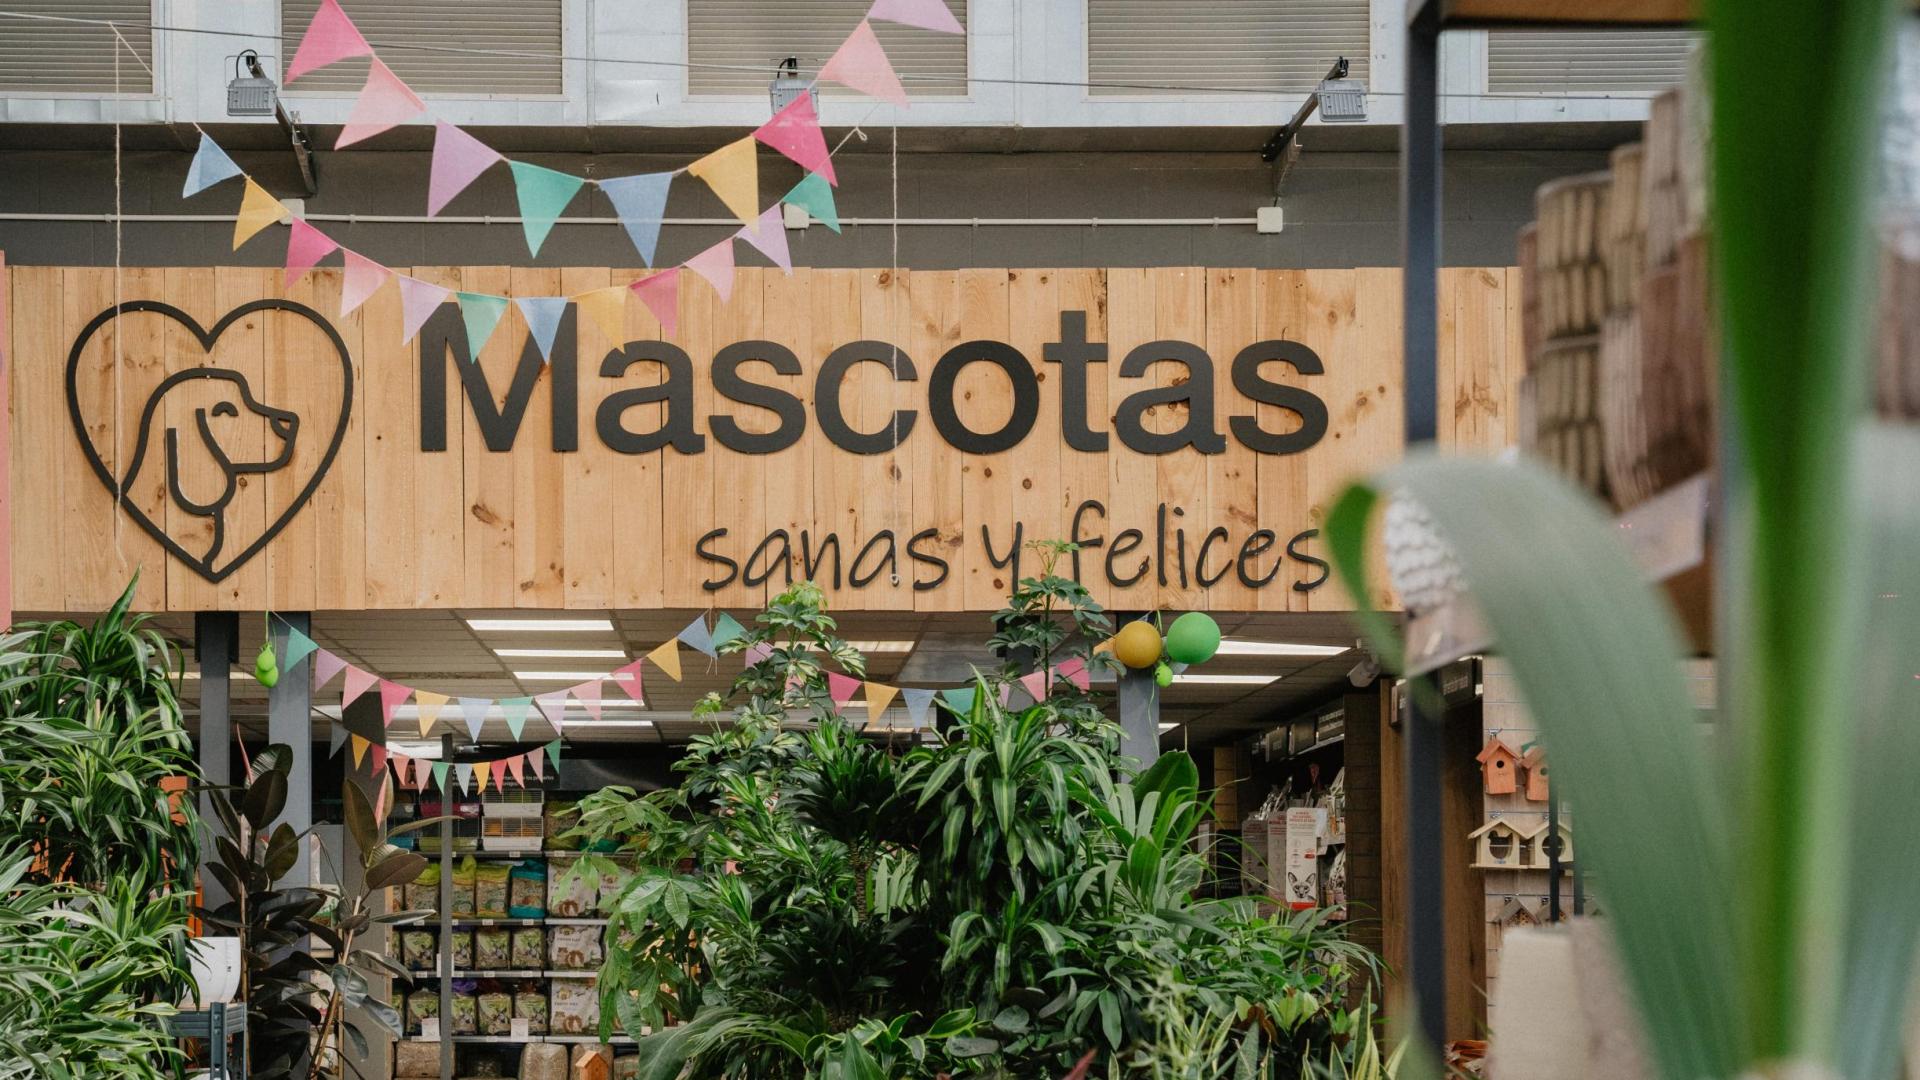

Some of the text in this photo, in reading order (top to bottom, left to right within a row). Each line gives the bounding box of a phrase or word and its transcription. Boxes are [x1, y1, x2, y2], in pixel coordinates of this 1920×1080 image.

[420, 301, 1329, 455] Mascotas
[696, 499, 1330, 594] sanas y felices
